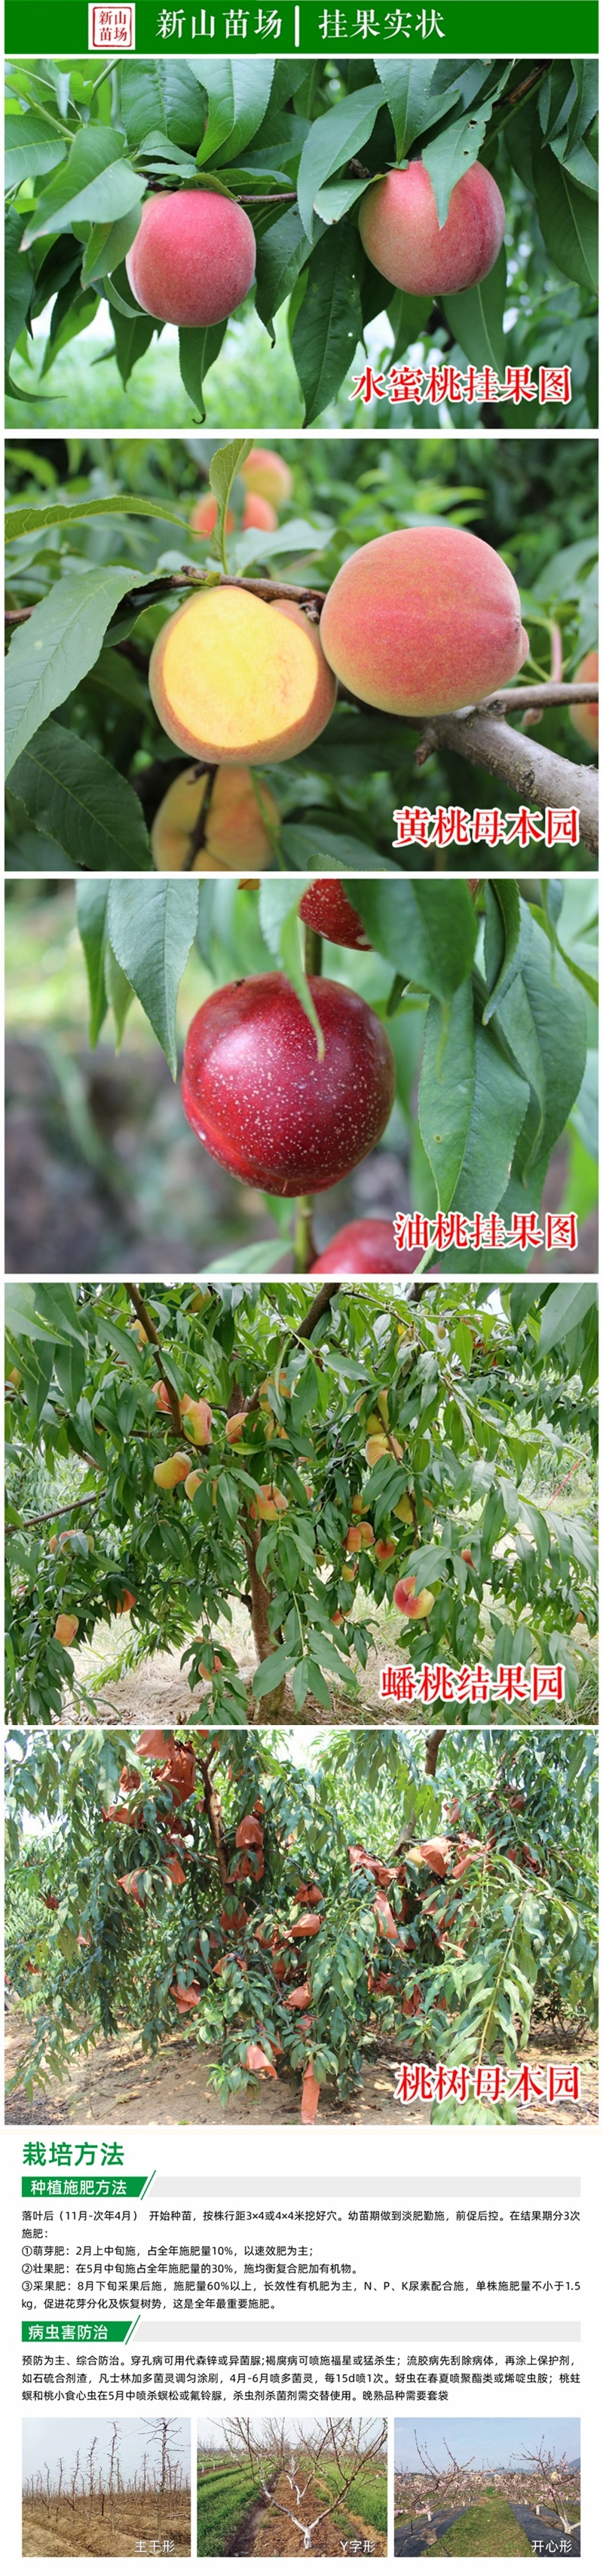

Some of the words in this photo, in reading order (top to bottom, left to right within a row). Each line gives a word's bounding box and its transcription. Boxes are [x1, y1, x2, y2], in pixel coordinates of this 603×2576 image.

[99, 11, 127, 25] 新山
[155, 8, 283, 39] 新山苗场
[318, 8, 446, 39] 挂果实状
[99, 27, 127, 41] 苗场
[23, 2141, 124, 2167] 栽培方法
[31, 2180, 127, 2195] 种植施肥方法
[21, 2228, 47, 2239] 施肥：
[29, 2324, 108, 2340] 病虫害防治
